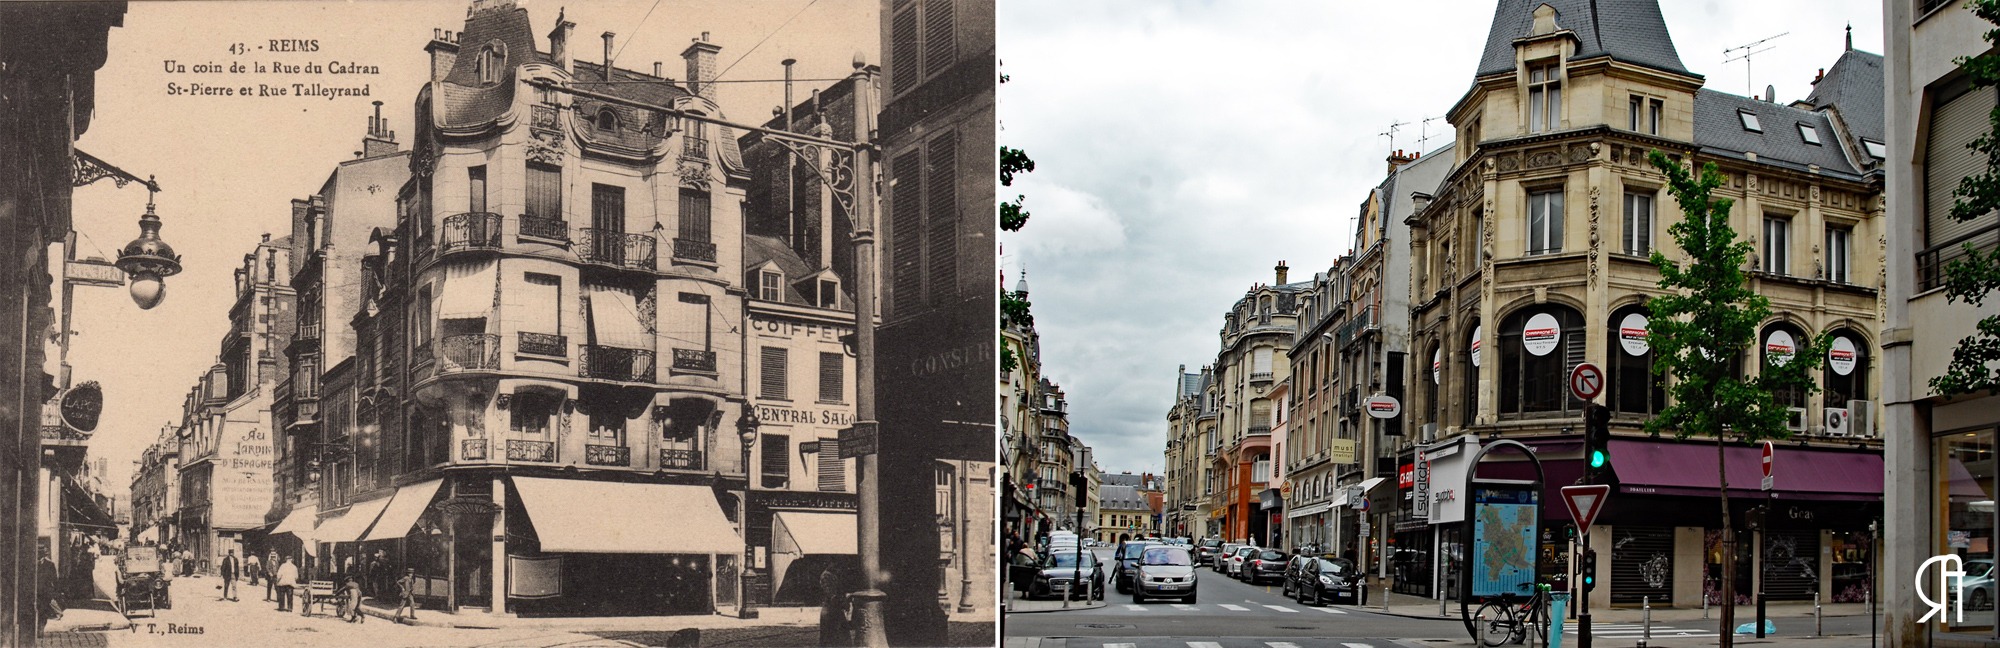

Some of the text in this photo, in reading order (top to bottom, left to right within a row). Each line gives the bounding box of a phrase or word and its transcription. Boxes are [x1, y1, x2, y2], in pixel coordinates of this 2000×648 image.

[752, 319, 849, 340] COIFFEU
[753, 405, 856, 426] CENTRAL SALO
[233, 442, 272, 457] JARDIN
[222, 458, 273, 469] D'ESPAGNE
[1417, 461, 1427, 511] swatch
